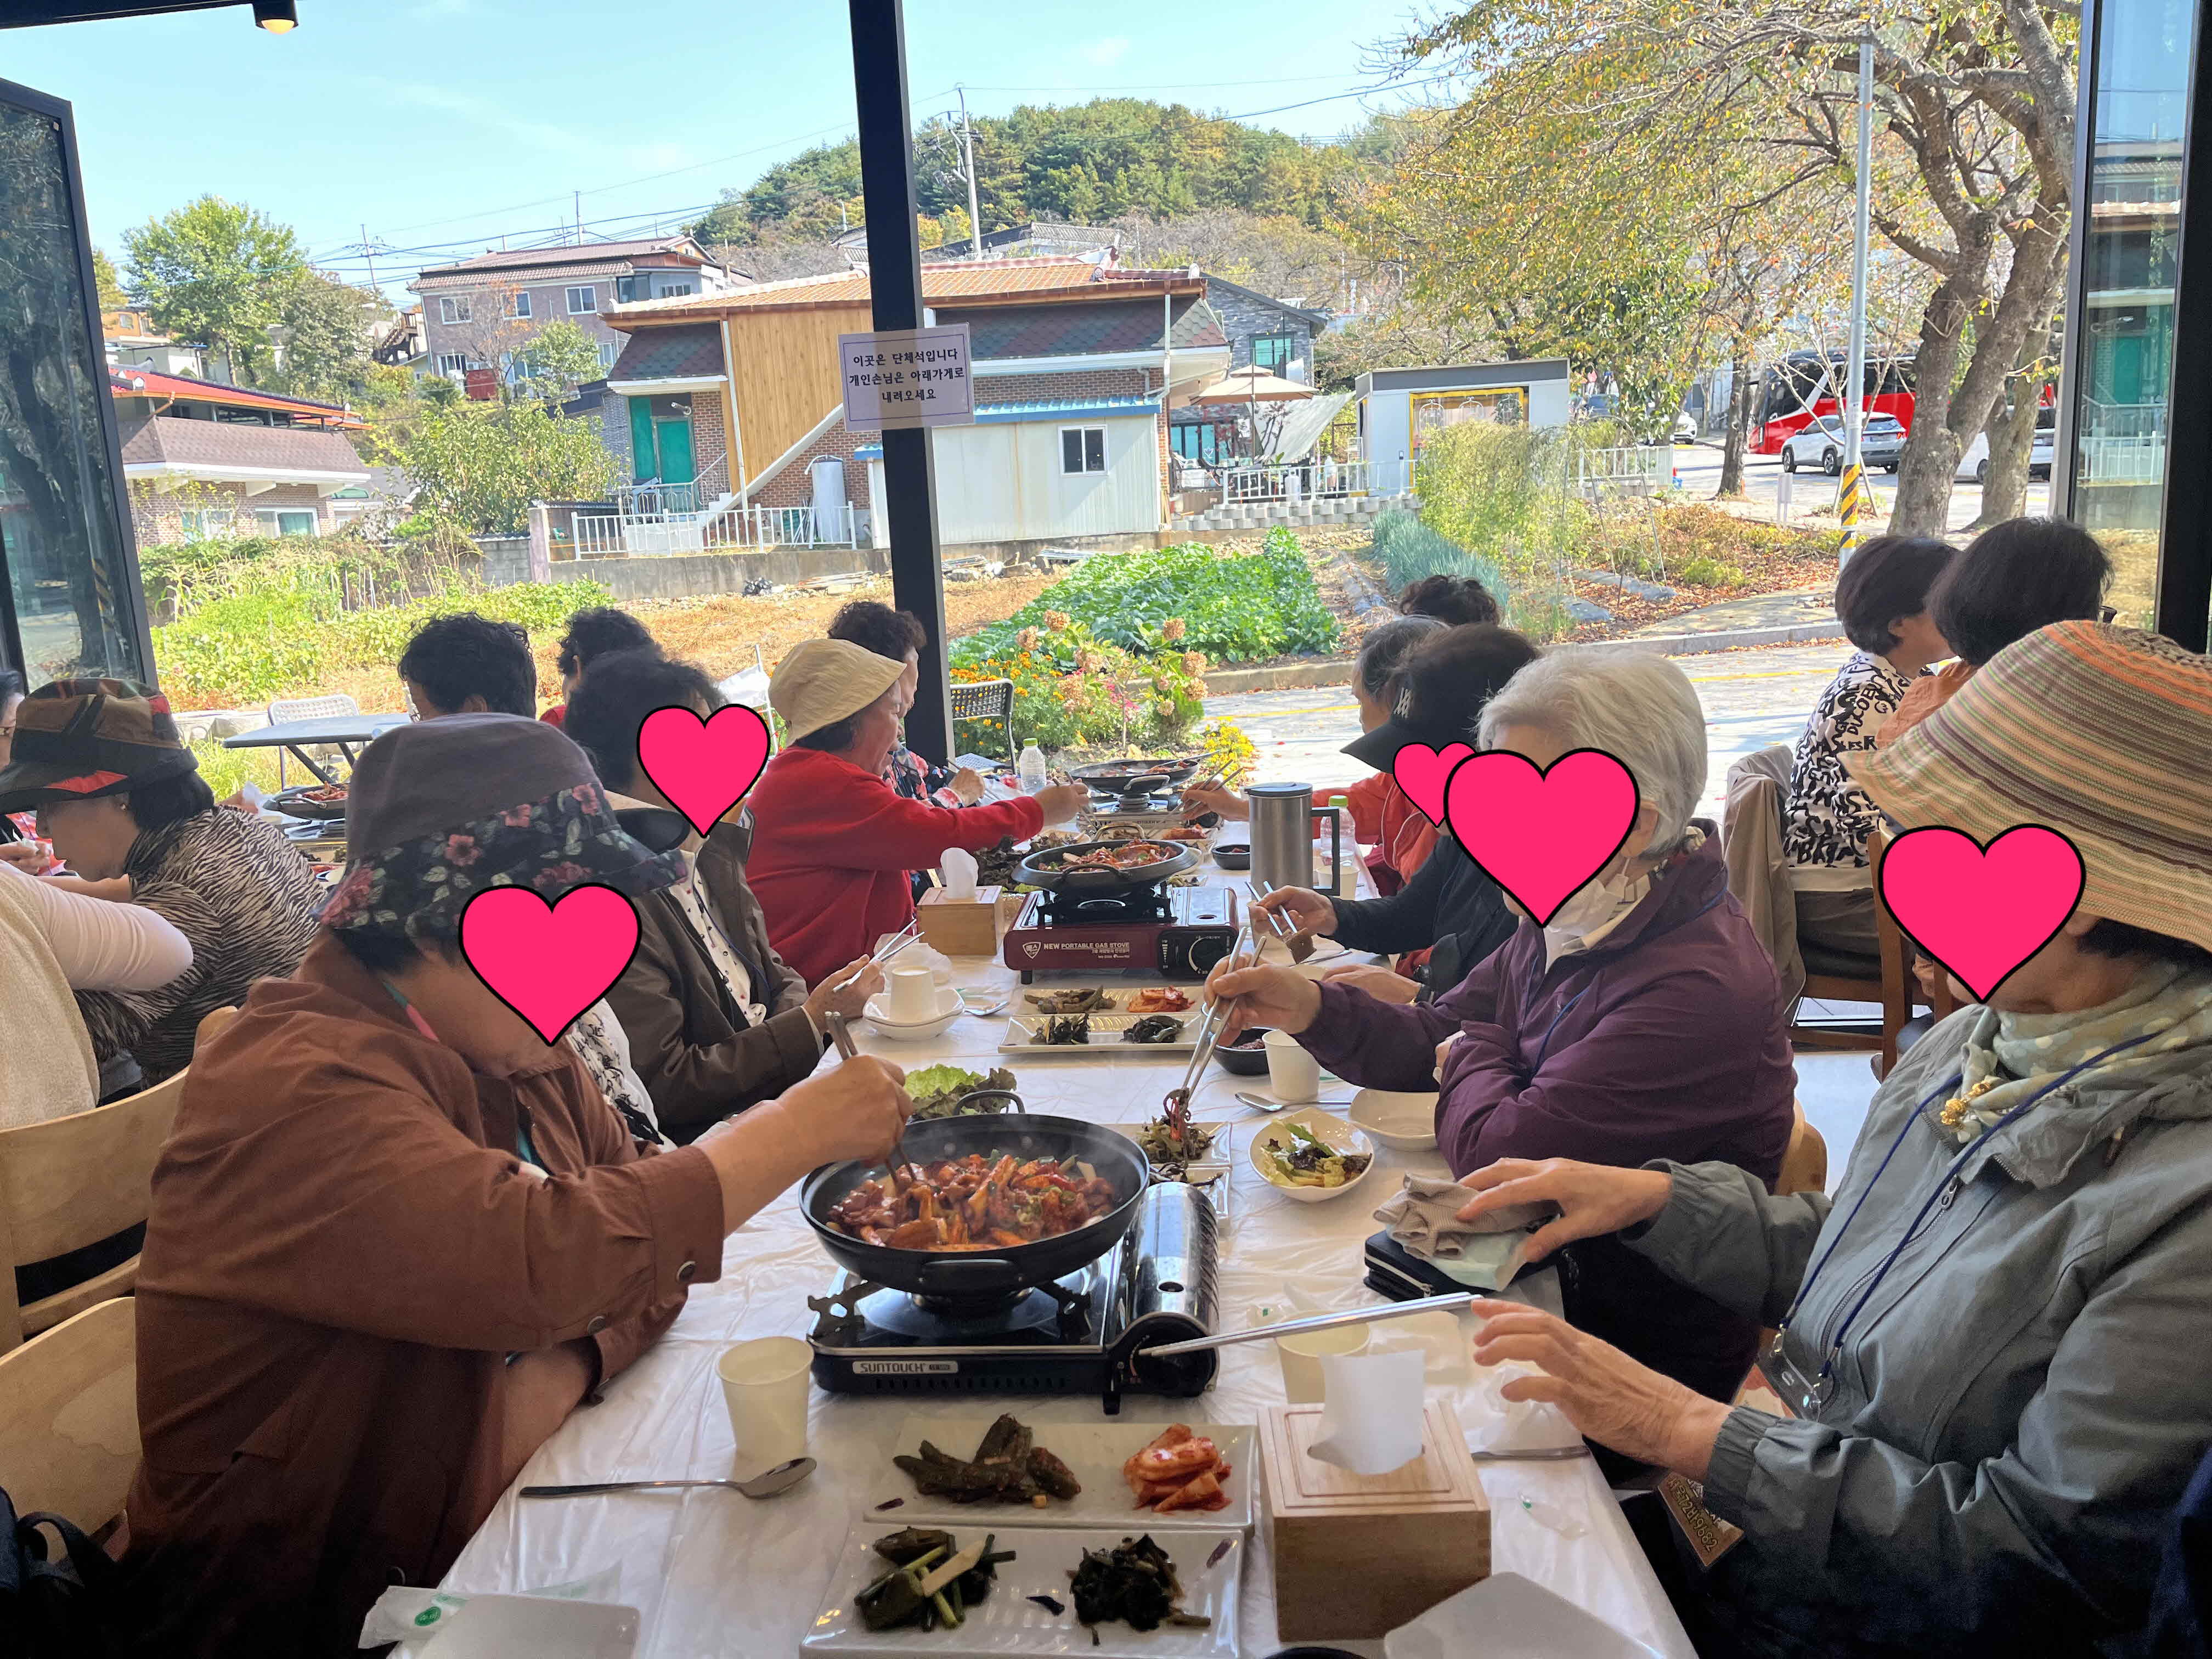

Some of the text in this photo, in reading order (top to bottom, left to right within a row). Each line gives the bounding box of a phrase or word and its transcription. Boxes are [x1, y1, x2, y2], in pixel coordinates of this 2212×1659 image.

[853, 348, 958, 367] 이곳은 단체석입니다
[849, 367, 964, 386] 개인손님은 아래가게로
[882, 388, 936, 404] 내려오세요
[860, 1363, 924, 1373] SUNTOUCH
